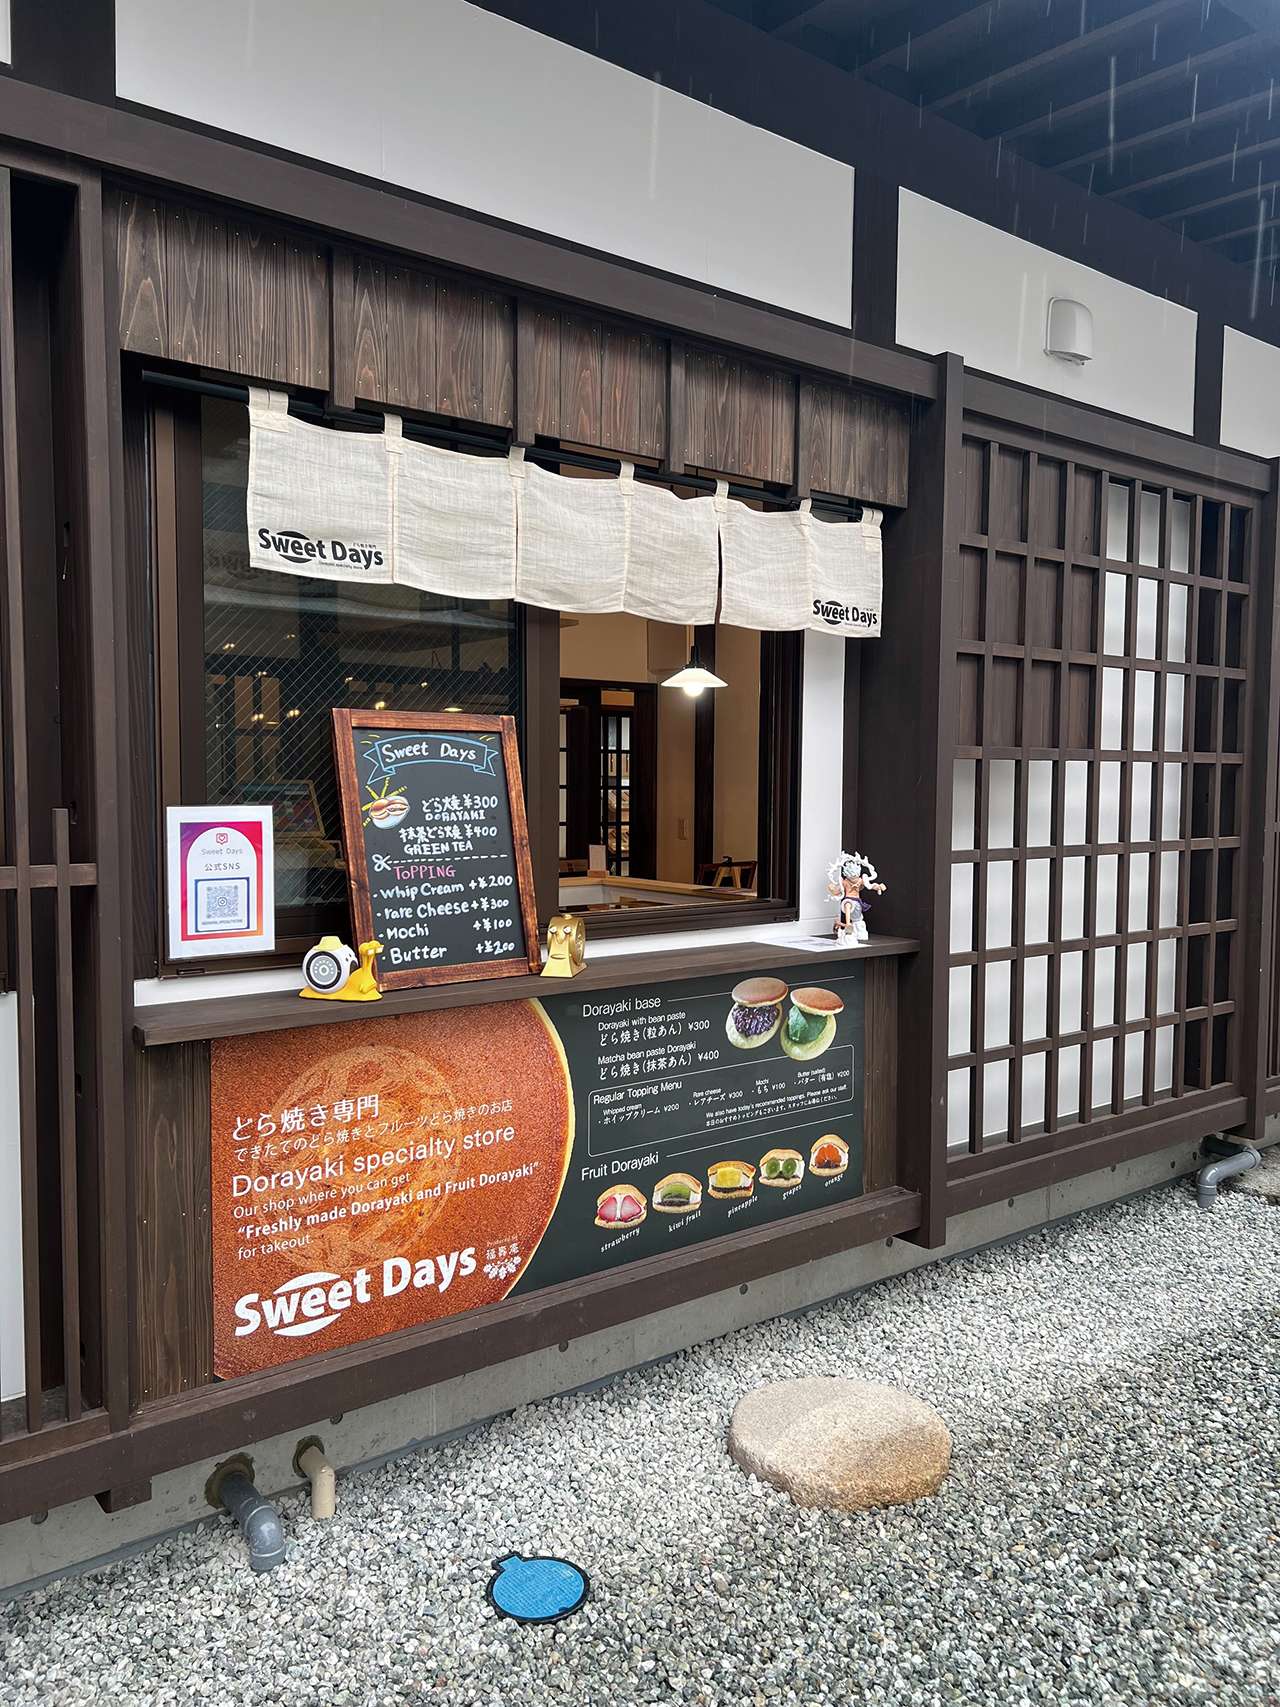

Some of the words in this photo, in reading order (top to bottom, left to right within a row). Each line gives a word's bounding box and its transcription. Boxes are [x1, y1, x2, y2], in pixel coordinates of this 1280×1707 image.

[258, 528, 327, 559] Sweet
[331, 540, 384, 570] Days
[812, 599, 850, 621] Sweet
[852, 606, 878, 628] Days
[382, 741, 429, 763] Sweet
[440, 743, 477, 761] Days
[421, 794, 463, 813] どら焼
[463, 794, 499, 809] ¥300
[398, 825, 463, 843] 抹茶どら焼
[464, 824, 498, 838] ¥400
[226, 848, 243, 856] Days
[403, 841, 450, 855] GREEN
[451, 840, 473, 851] TEA
[204, 862, 241, 871] 公式SNS
[384, 907, 413, 920] rare
[416, 902, 470, 918] Cheese
[386, 923, 430, 940] Mochi
[389, 945, 448, 965] Butter
[583, 998, 632, 1018] Dorayaki
[635, 997, 662, 1010] base
[598, 1019, 630, 1031] Dorayaki
[631, 1016, 647, 1026] with
[648, 1014, 666, 1023] bean
[666, 1011, 686, 1022] paste
[688, 1019, 710, 1031] ¥300
[597, 1053, 626, 1065] Matcha
[626, 1050, 645, 1060] bean
[645, 1048, 666, 1059] paste
[667, 1041, 697, 1054] Dorayaki
[697, 1049, 720, 1062] ¥400
[755, 1078, 770, 1086] Mochi
[771, 1082, 786, 1091] ¥100
[593, 1091, 625, 1105] Regular
[627, 1085, 659, 1098] Topping
[660, 1081, 683, 1092] Menu
[232, 1094, 380, 1142] どら焼き専門
[603, 1105, 626, 1116] Whipped
[626, 1103, 643, 1112] cream
[663, 1103, 680, 1113] ¥200
[234, 1098, 513, 1163] できたてのどら焼きとフルーツどら焼きのお店
[232, 1153, 345, 1197] Dorayaki
[353, 1134, 456, 1173] specialty
[462, 1126, 515, 1150] store
[581, 1164, 608, 1181] Fruit
[611, 1151, 659, 1175] Dorayaki
[824, 1174, 844, 1187] orange
[233, 1205, 259, 1219] Our
[262, 1196, 295, 1215] shop
[298, 1187, 338, 1205] where
[340, 1183, 364, 1202] you
[366, 1178, 389, 1193] can
[391, 1171, 411, 1191] get
[306, 1205, 347, 1226] made
[351, 1191, 414, 1217] Dorayaki
[416, 1184, 442, 1200] and
[444, 1177, 476, 1195] Fruit
[782, 1184, 802, 1201] grapes
[727, 1194, 758, 1218] pineapple
[668, 1218, 685, 1233] kiwi
[685, 1210, 702, 1227] fruit
[238, 1245, 259, 1260] for
[260, 1232, 315, 1256] takeout.
[600, 1226, 641, 1253] strawberry
[234, 1268, 372, 1337] Sweet
[382, 1246, 477, 1298] Days
